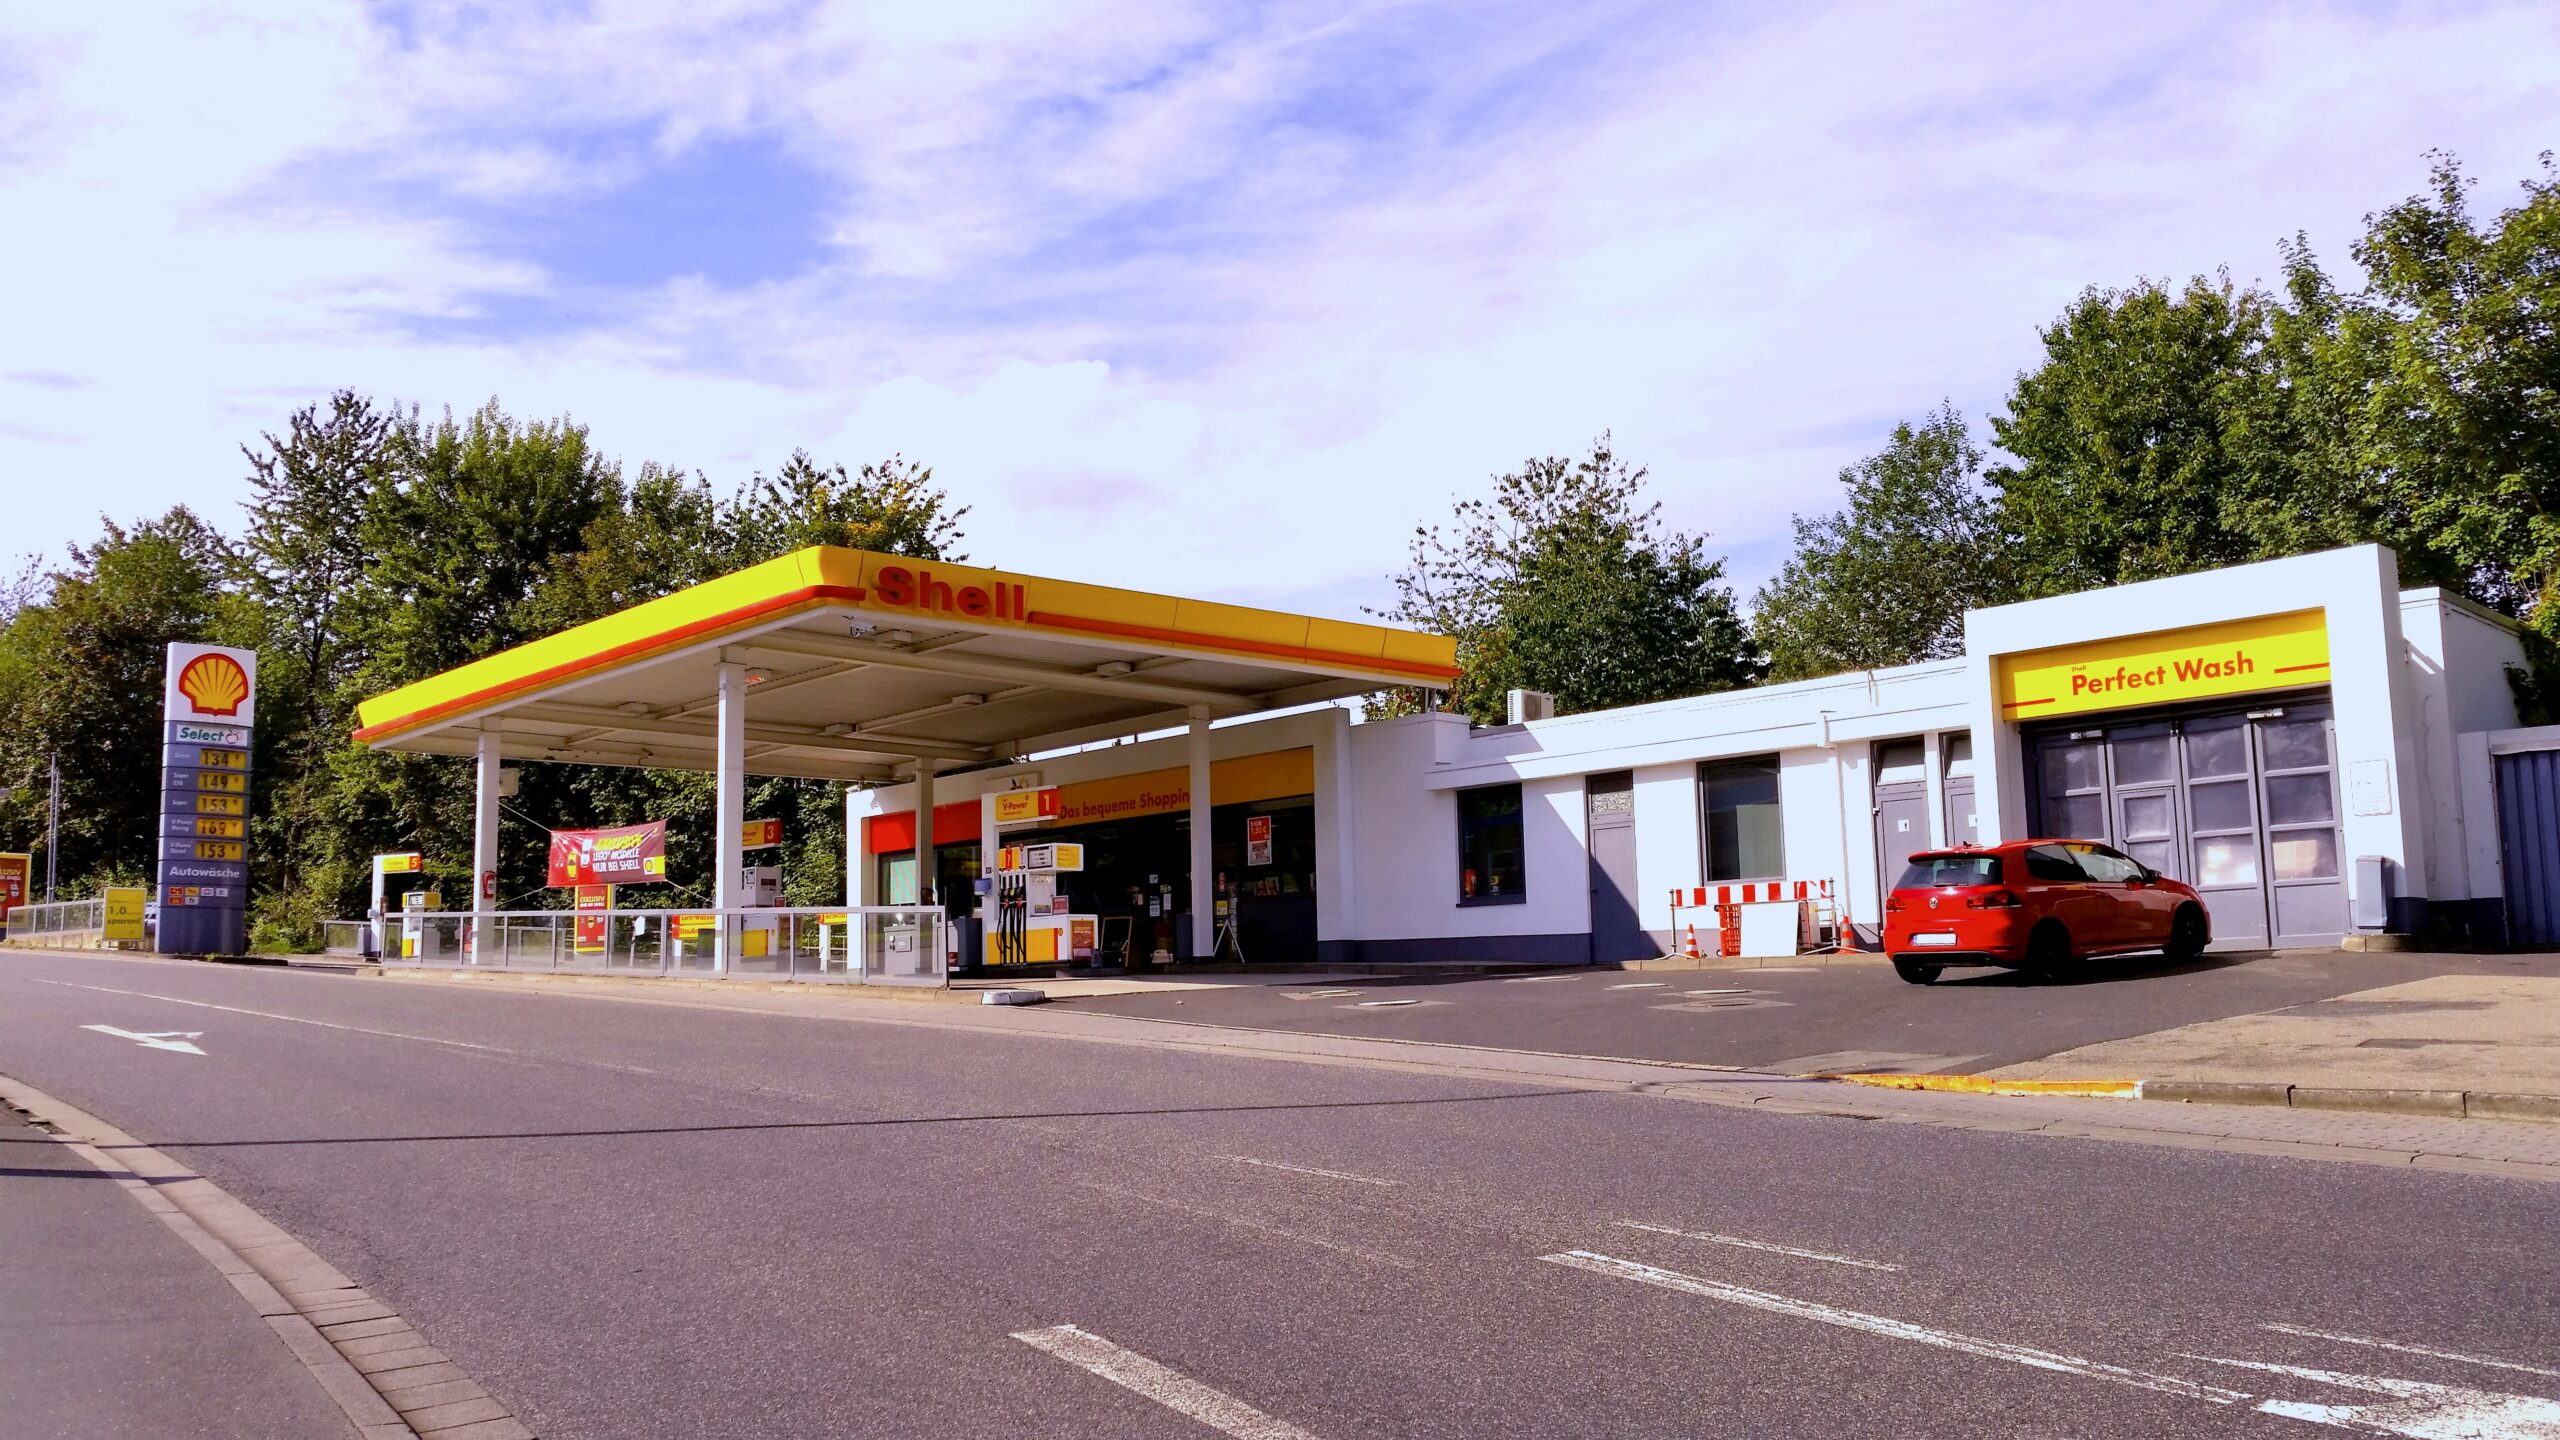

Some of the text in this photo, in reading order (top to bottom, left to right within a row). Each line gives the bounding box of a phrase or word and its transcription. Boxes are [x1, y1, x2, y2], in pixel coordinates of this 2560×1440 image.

[877, 566, 1024, 620] Shell
[2072, 651, 2254, 696] Perfect Wash
[180, 727, 224, 741] Select
[202, 751, 229, 766] 134
[202, 774, 228, 789] 149
[202, 798, 227, 812] 153
[1003, 802, 1028, 811] V-Power
[1043, 794, 1050, 811] 1
[1060, 806, 1080, 819] Das
[1083, 799, 1136, 818] bequeme
[767, 825, 774, 840] 3
[200, 843, 225, 858] 153
[411, 857, 417, 868] 5
[592, 859, 640, 872] NUR BEI SHELL
[169, 866, 240, 878] Autowäsche
